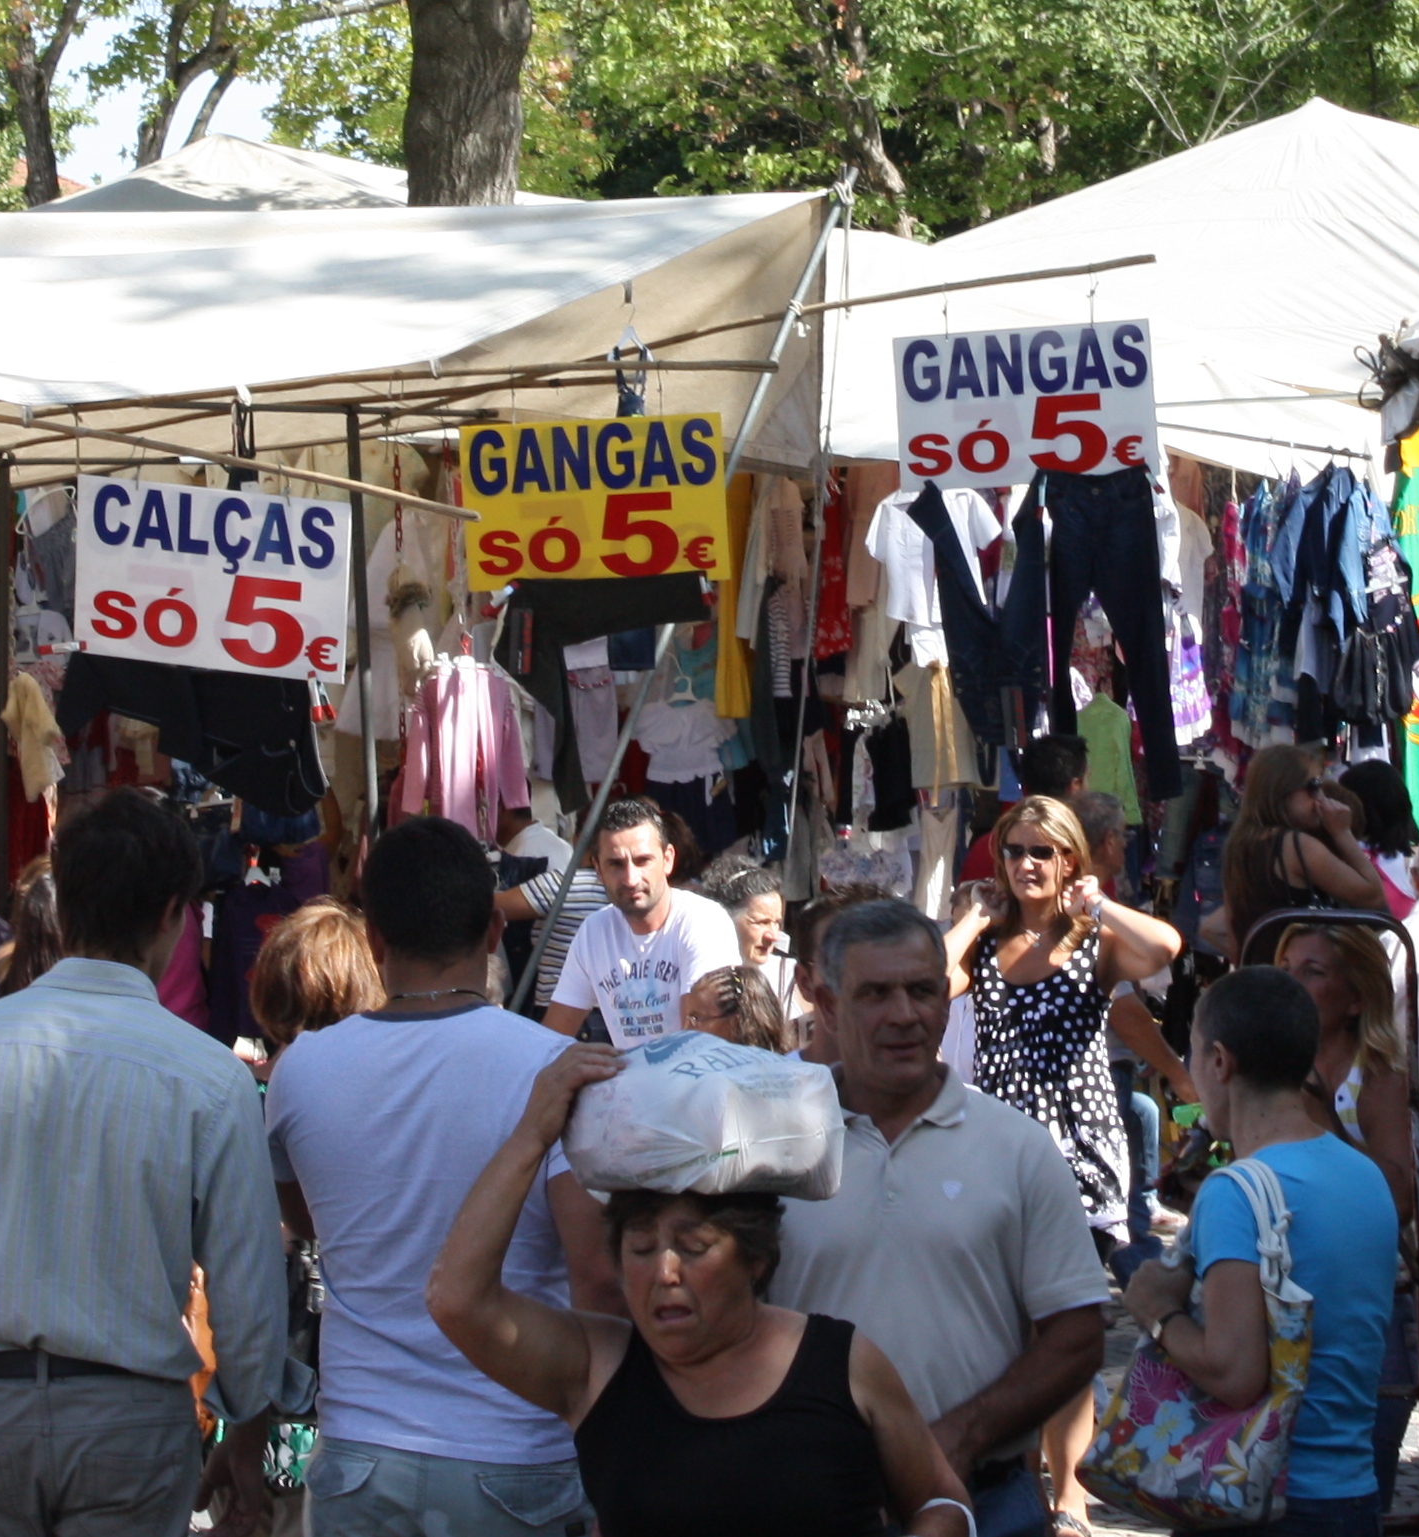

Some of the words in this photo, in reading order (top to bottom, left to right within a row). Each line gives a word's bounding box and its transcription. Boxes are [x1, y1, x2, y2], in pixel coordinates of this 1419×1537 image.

[902, 324, 1148, 402] GANGAS
[469, 418, 717, 496] GANGAS
[93, 484, 335, 575] CALÇAS
